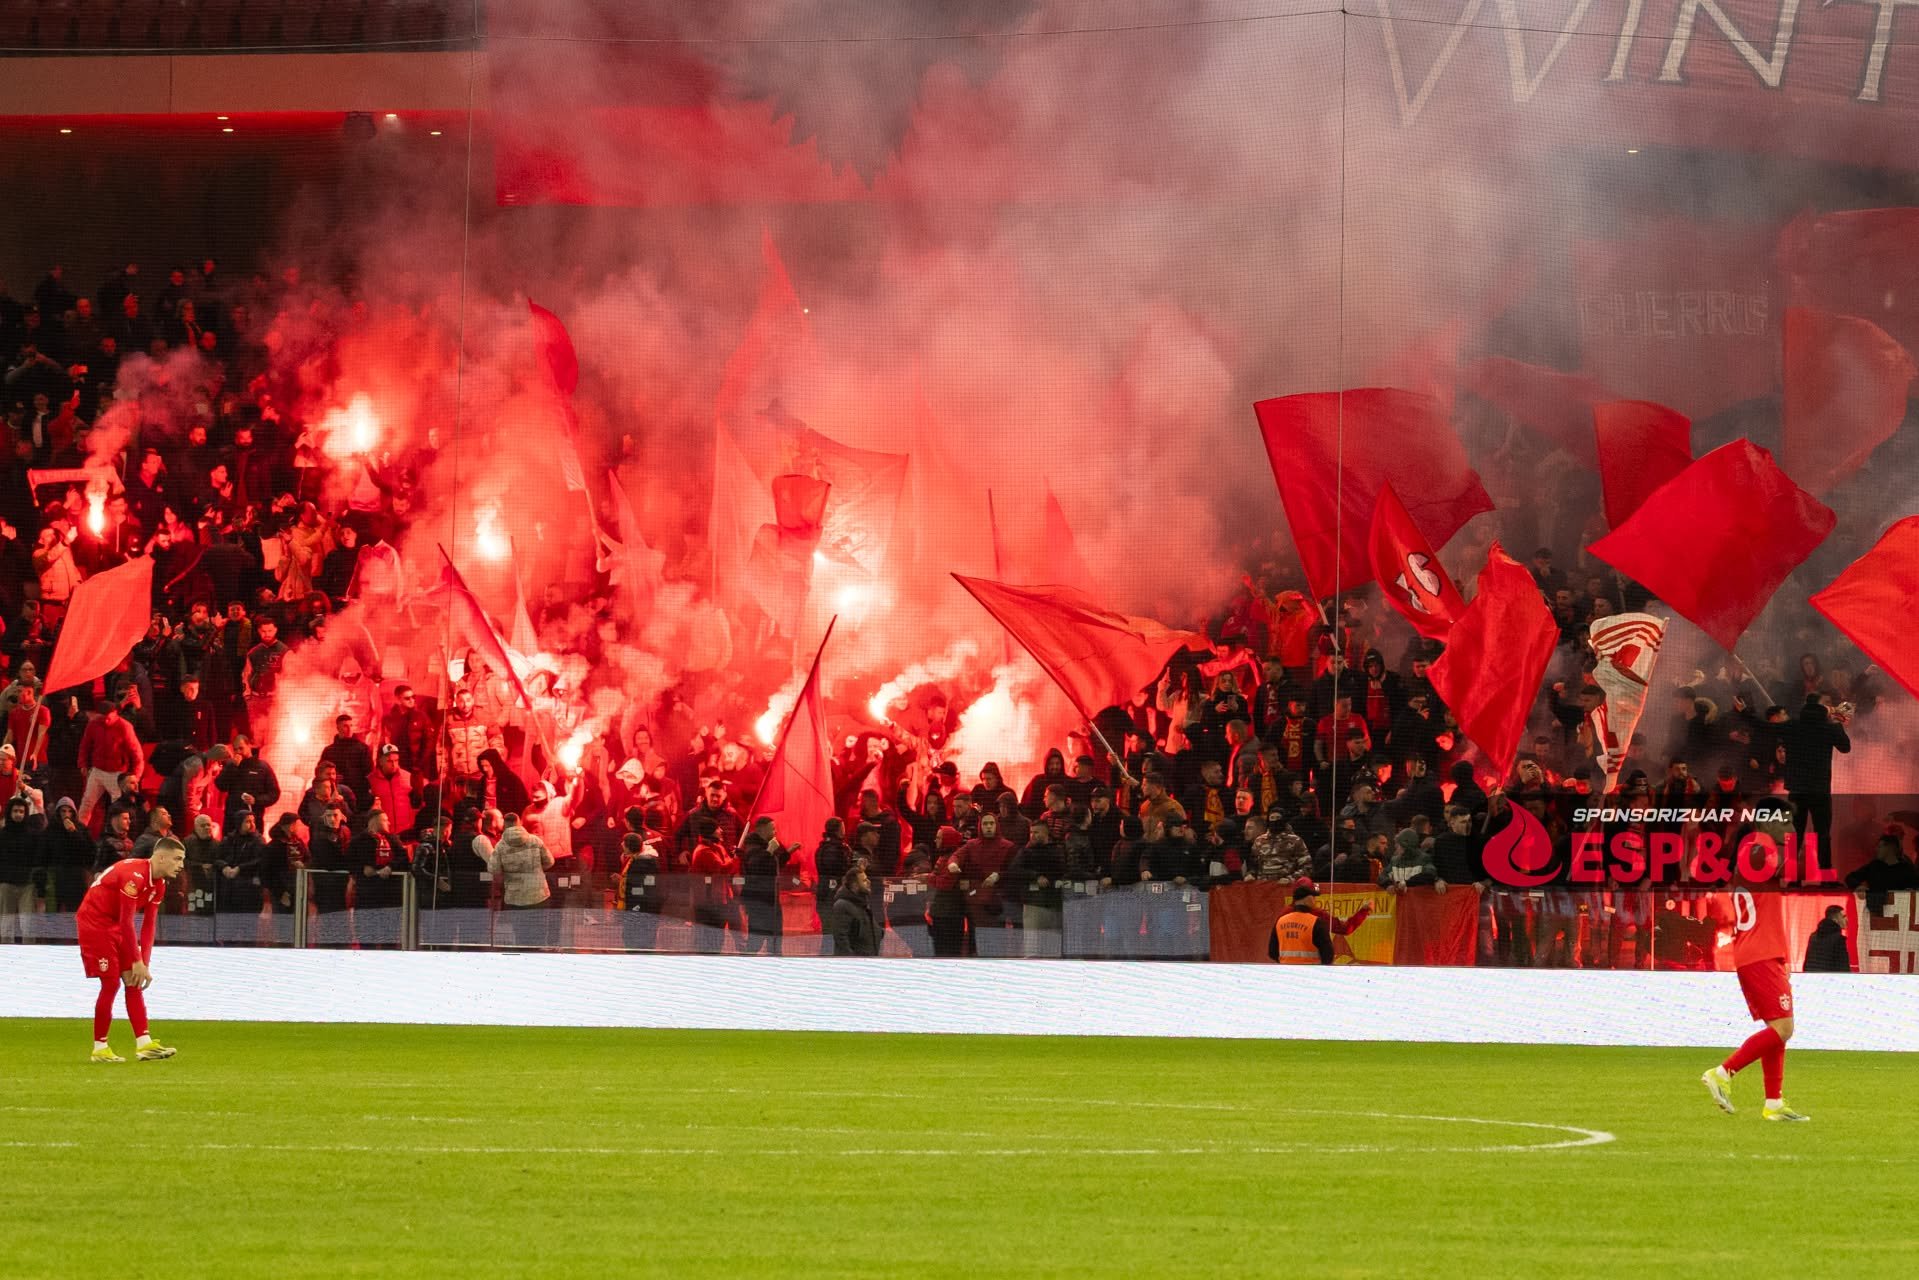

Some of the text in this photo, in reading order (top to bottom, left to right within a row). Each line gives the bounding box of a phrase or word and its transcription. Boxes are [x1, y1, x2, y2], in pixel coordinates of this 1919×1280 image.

[1316, 896, 1390, 916] PARTIZNI
[1733, 886, 1757, 934] 0
[1280, 921, 1309, 932] SECURITY
